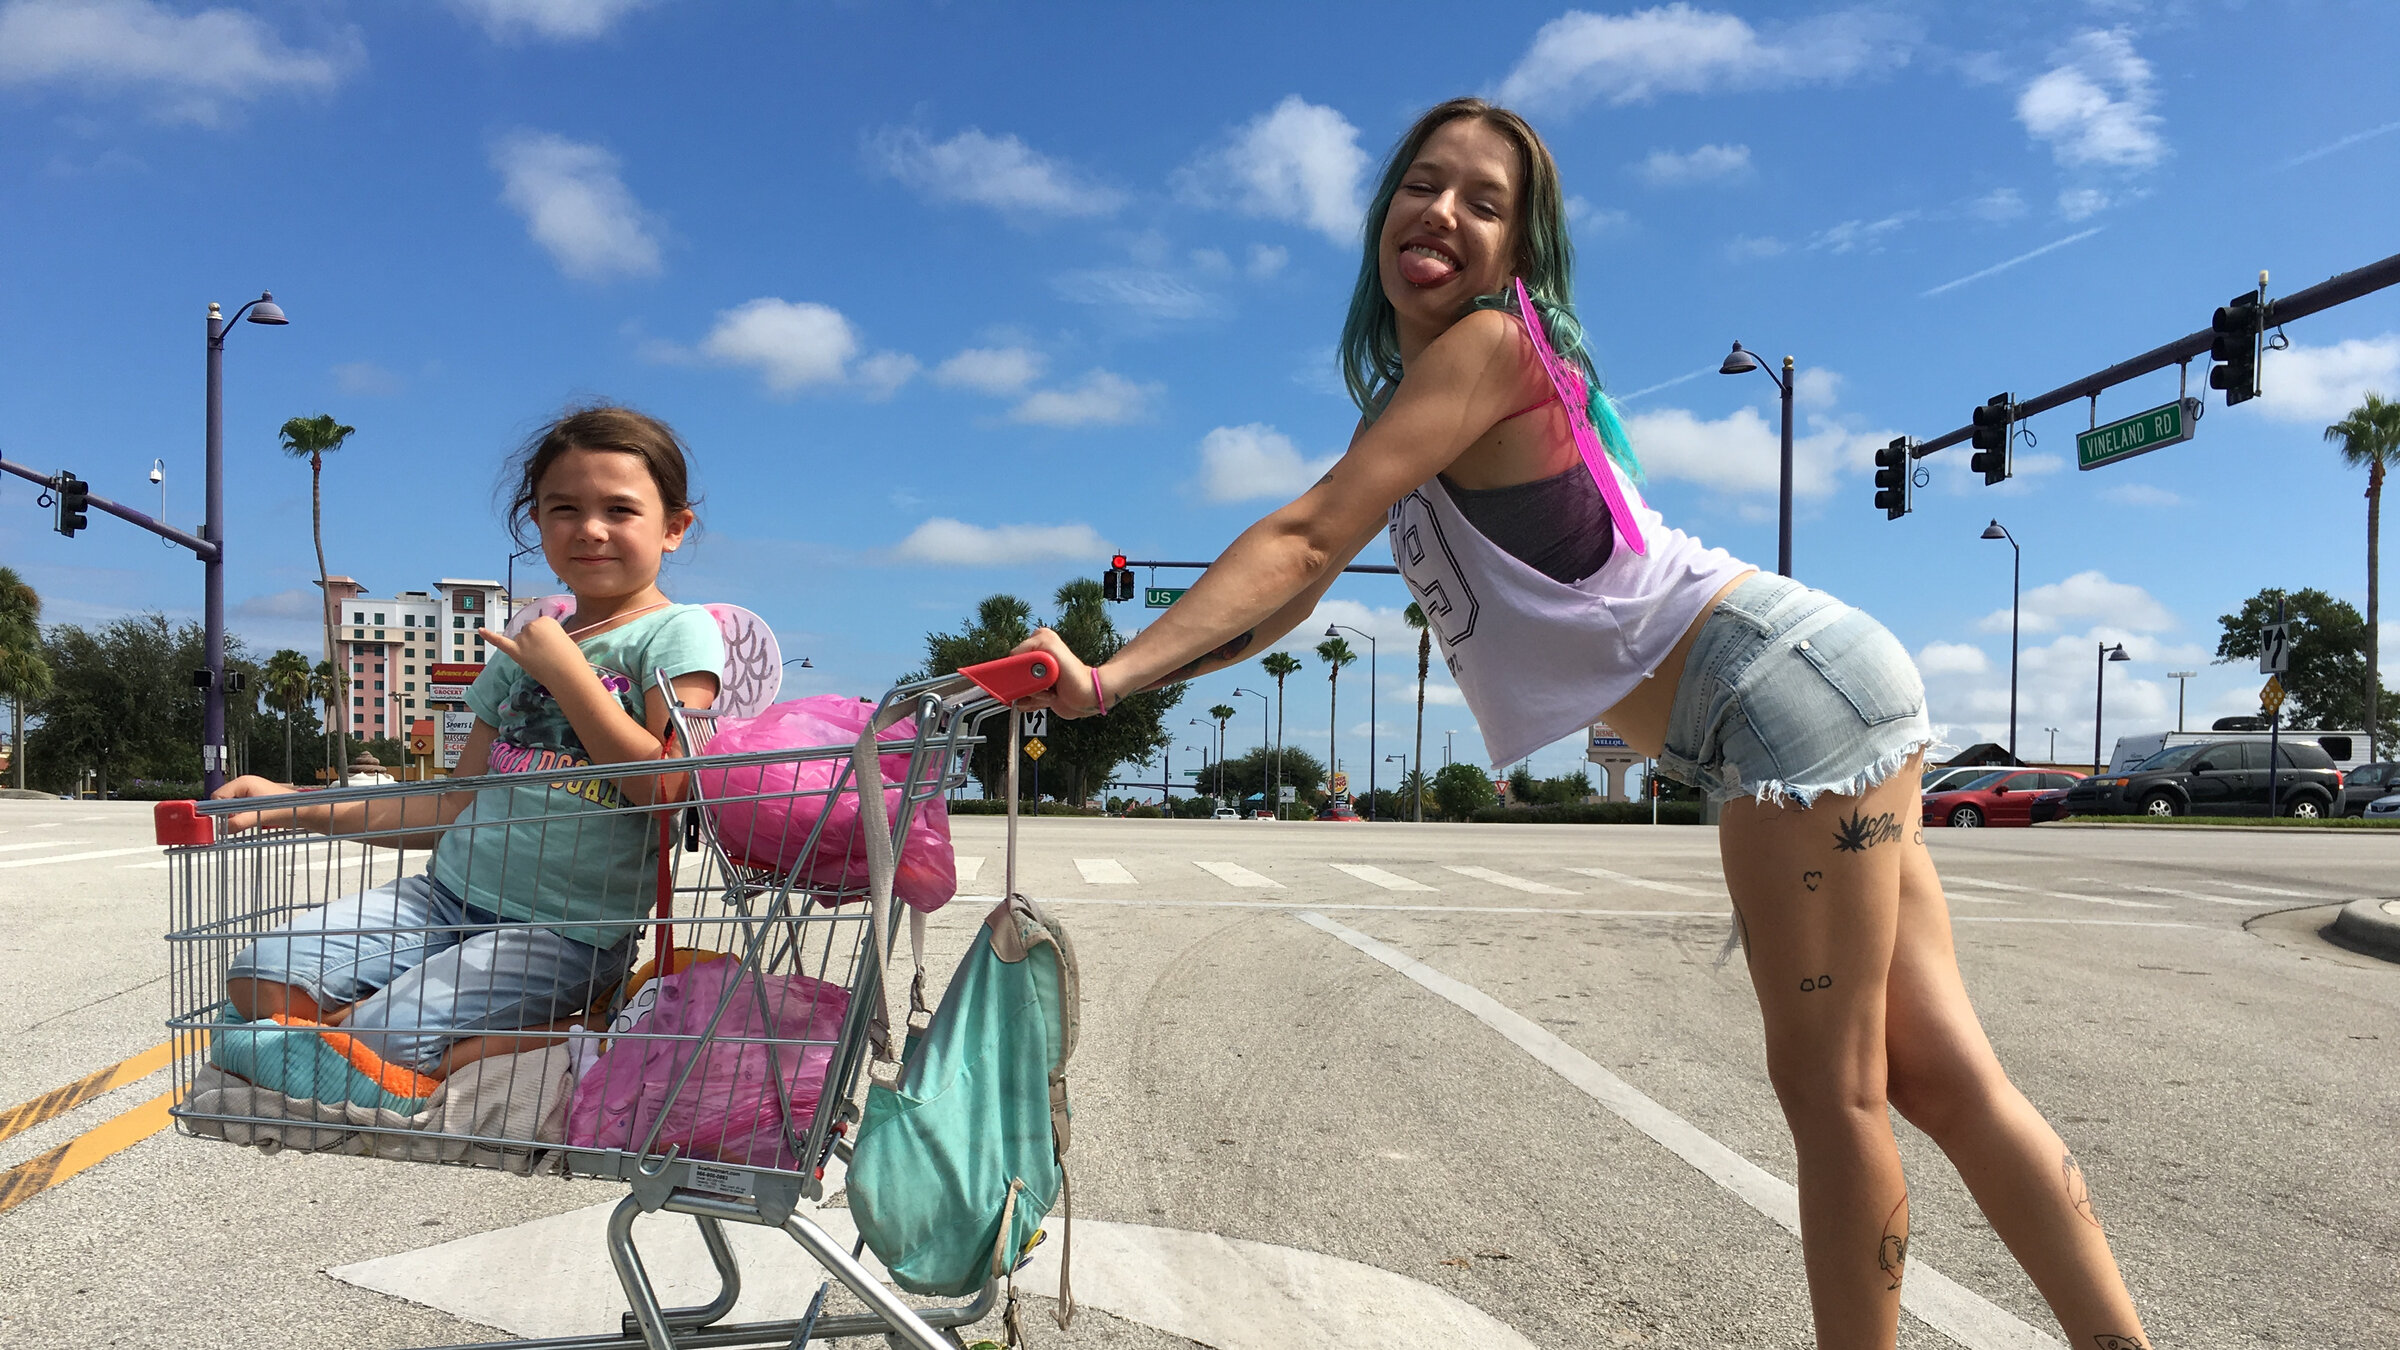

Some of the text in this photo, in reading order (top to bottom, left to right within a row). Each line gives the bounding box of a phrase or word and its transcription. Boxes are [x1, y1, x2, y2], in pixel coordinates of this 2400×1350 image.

[2086, 412, 2172, 458] VINELAND RD
[1148, 591, 1171, 604] US
[445, 721, 468, 729] SPORTS
